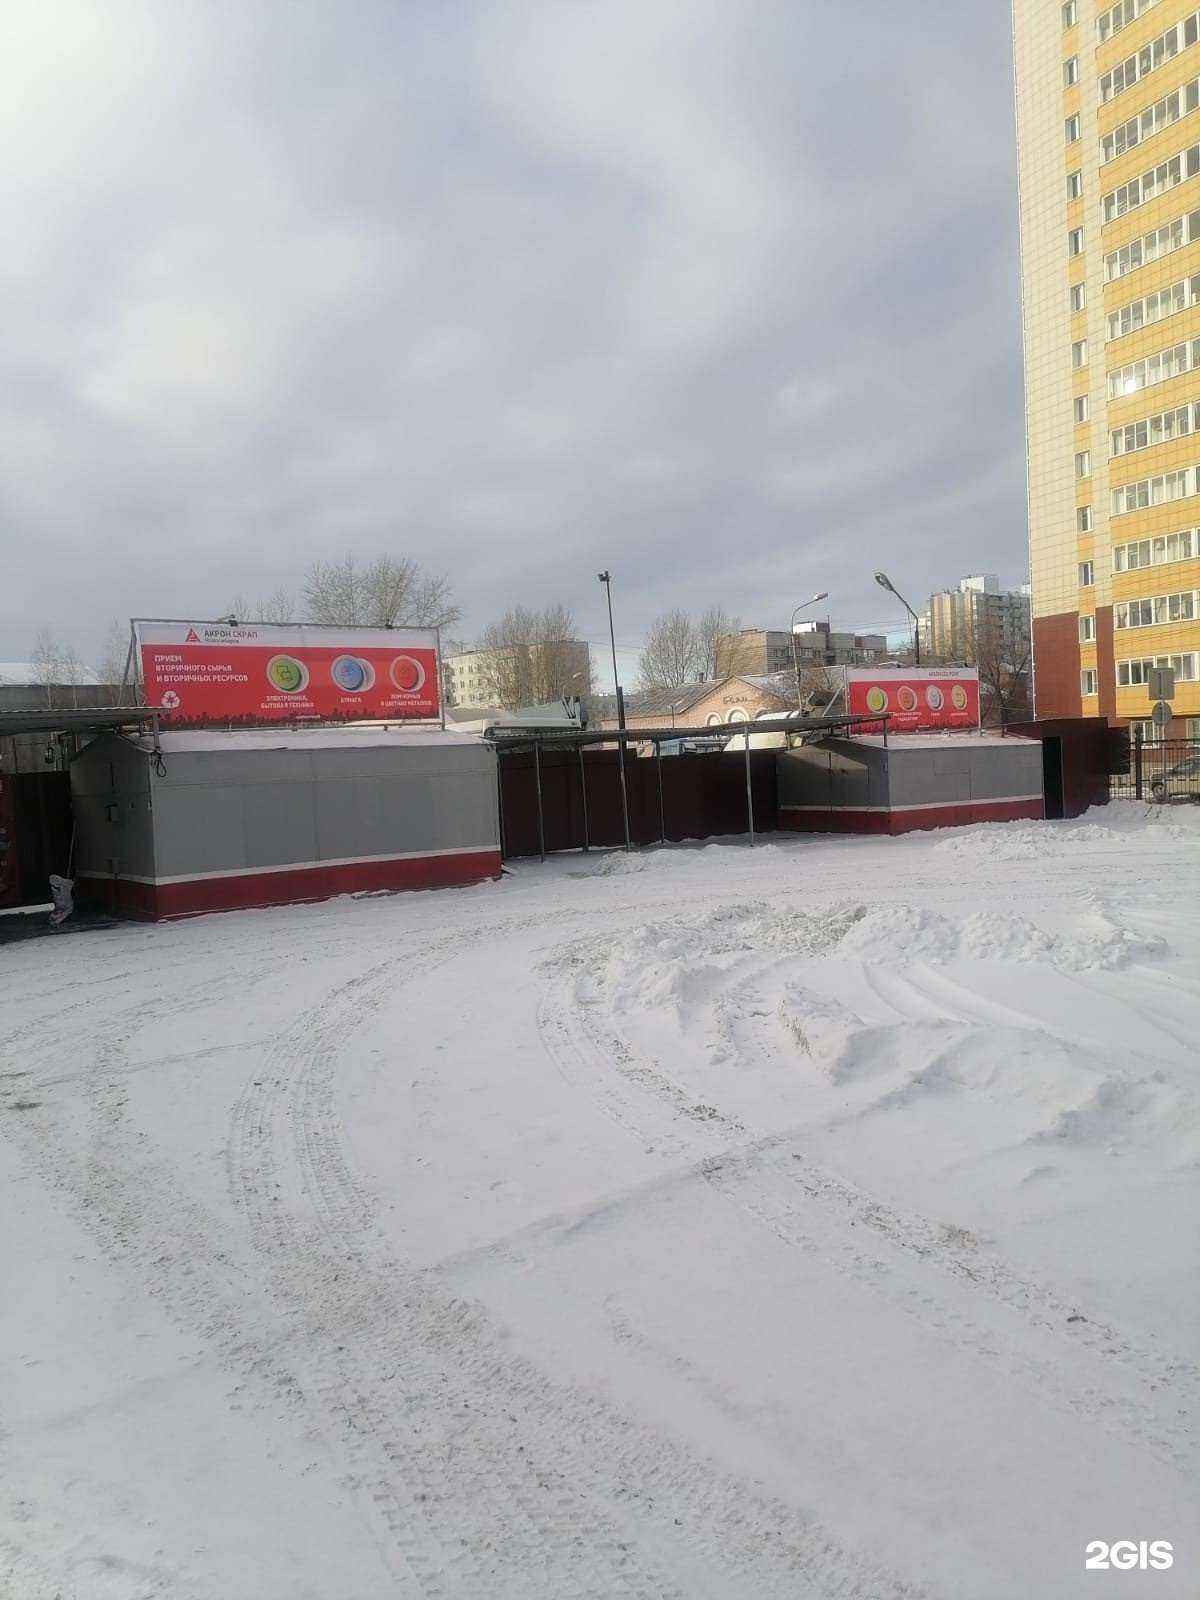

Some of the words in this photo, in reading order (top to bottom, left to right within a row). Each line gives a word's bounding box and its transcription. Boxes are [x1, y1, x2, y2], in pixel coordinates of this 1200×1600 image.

[204, 630, 230, 638] АКРОН
[232, 631, 258, 640] СКРАП
[155, 664, 206, 672] ВТОРИЧНОГО
[207, 664, 232, 672] СЫРЬЯ
[164, 674, 211, 682] ВТОРИЧНЫХ
[212, 674, 249, 682] РЕСУРСОВ
